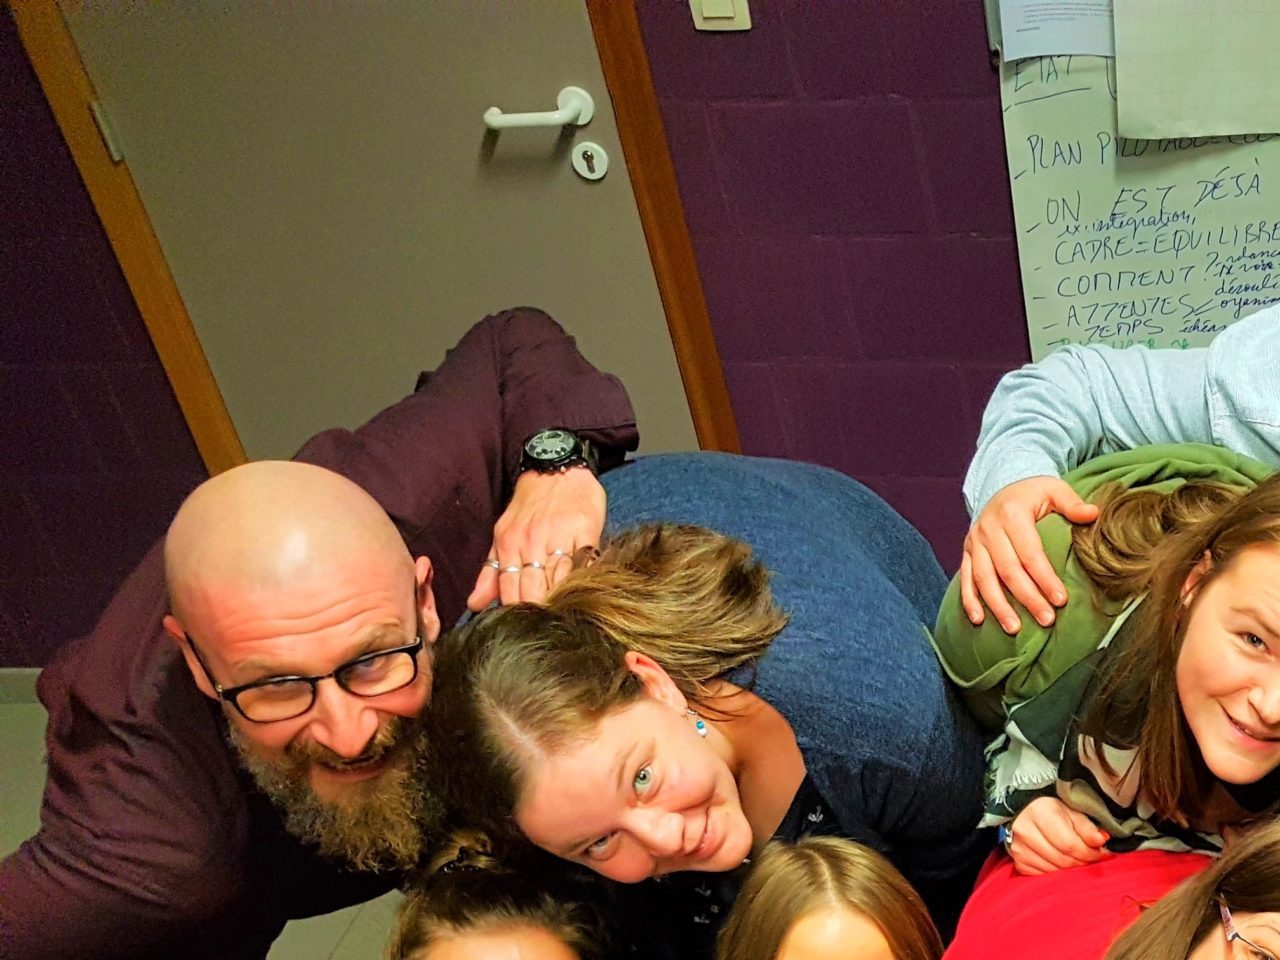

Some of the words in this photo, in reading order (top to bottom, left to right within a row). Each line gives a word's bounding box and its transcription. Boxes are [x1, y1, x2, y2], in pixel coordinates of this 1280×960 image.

[1027, 134, 1082, 174] PLAN
[1046, 190, 1082, 225] ON
[1067, 294, 1195, 327] ATTENTES
[1085, 319, 1164, 342] TEMPS
